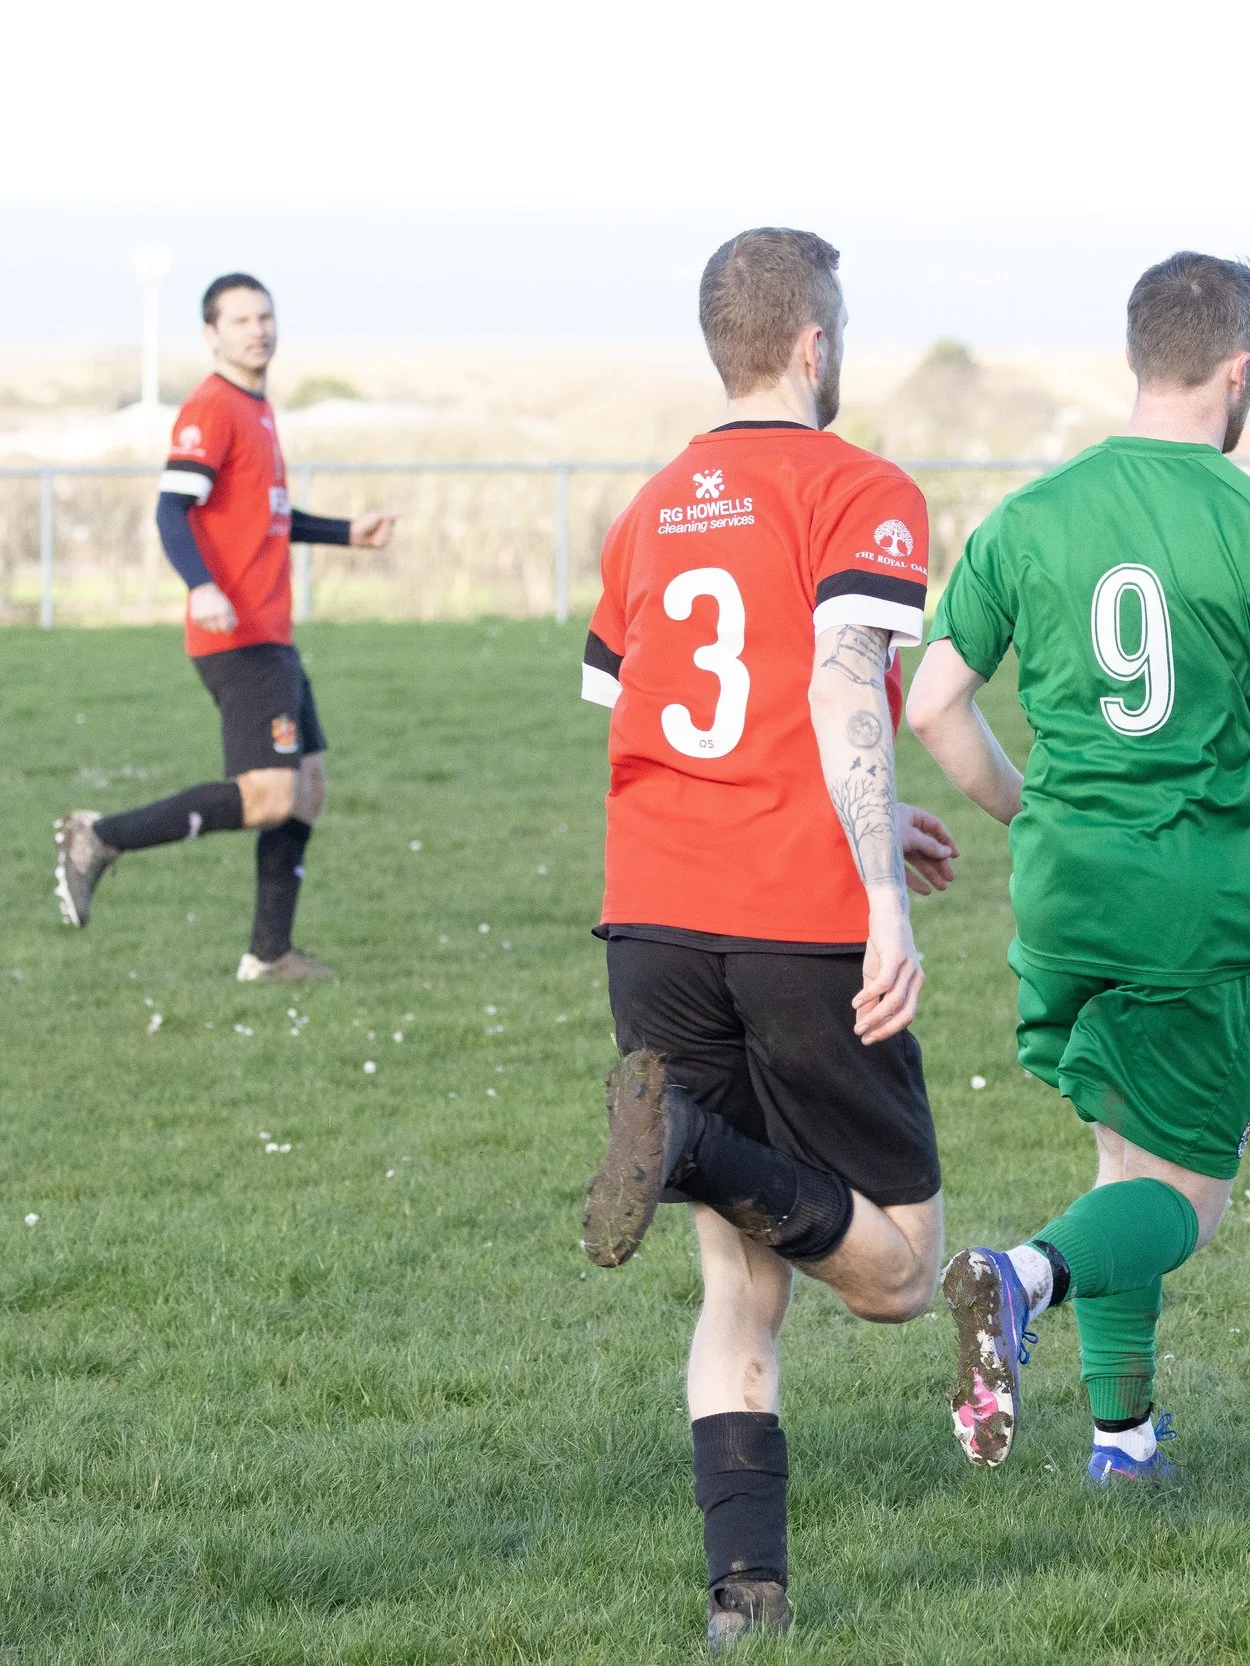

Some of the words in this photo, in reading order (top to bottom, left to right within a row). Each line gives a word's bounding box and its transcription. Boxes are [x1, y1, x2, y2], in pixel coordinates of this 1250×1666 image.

[660, 507, 683, 523] RG
[686, 497, 753, 520] HOWELLS
[657, 521, 708, 536] cleaning
[709, 514, 755, 529] services
[855, 551, 875, 561] THE
[877, 555, 908, 568] ROYAL
[1091, 563, 1175, 736] 9
[661, 567, 750, 759] 3
